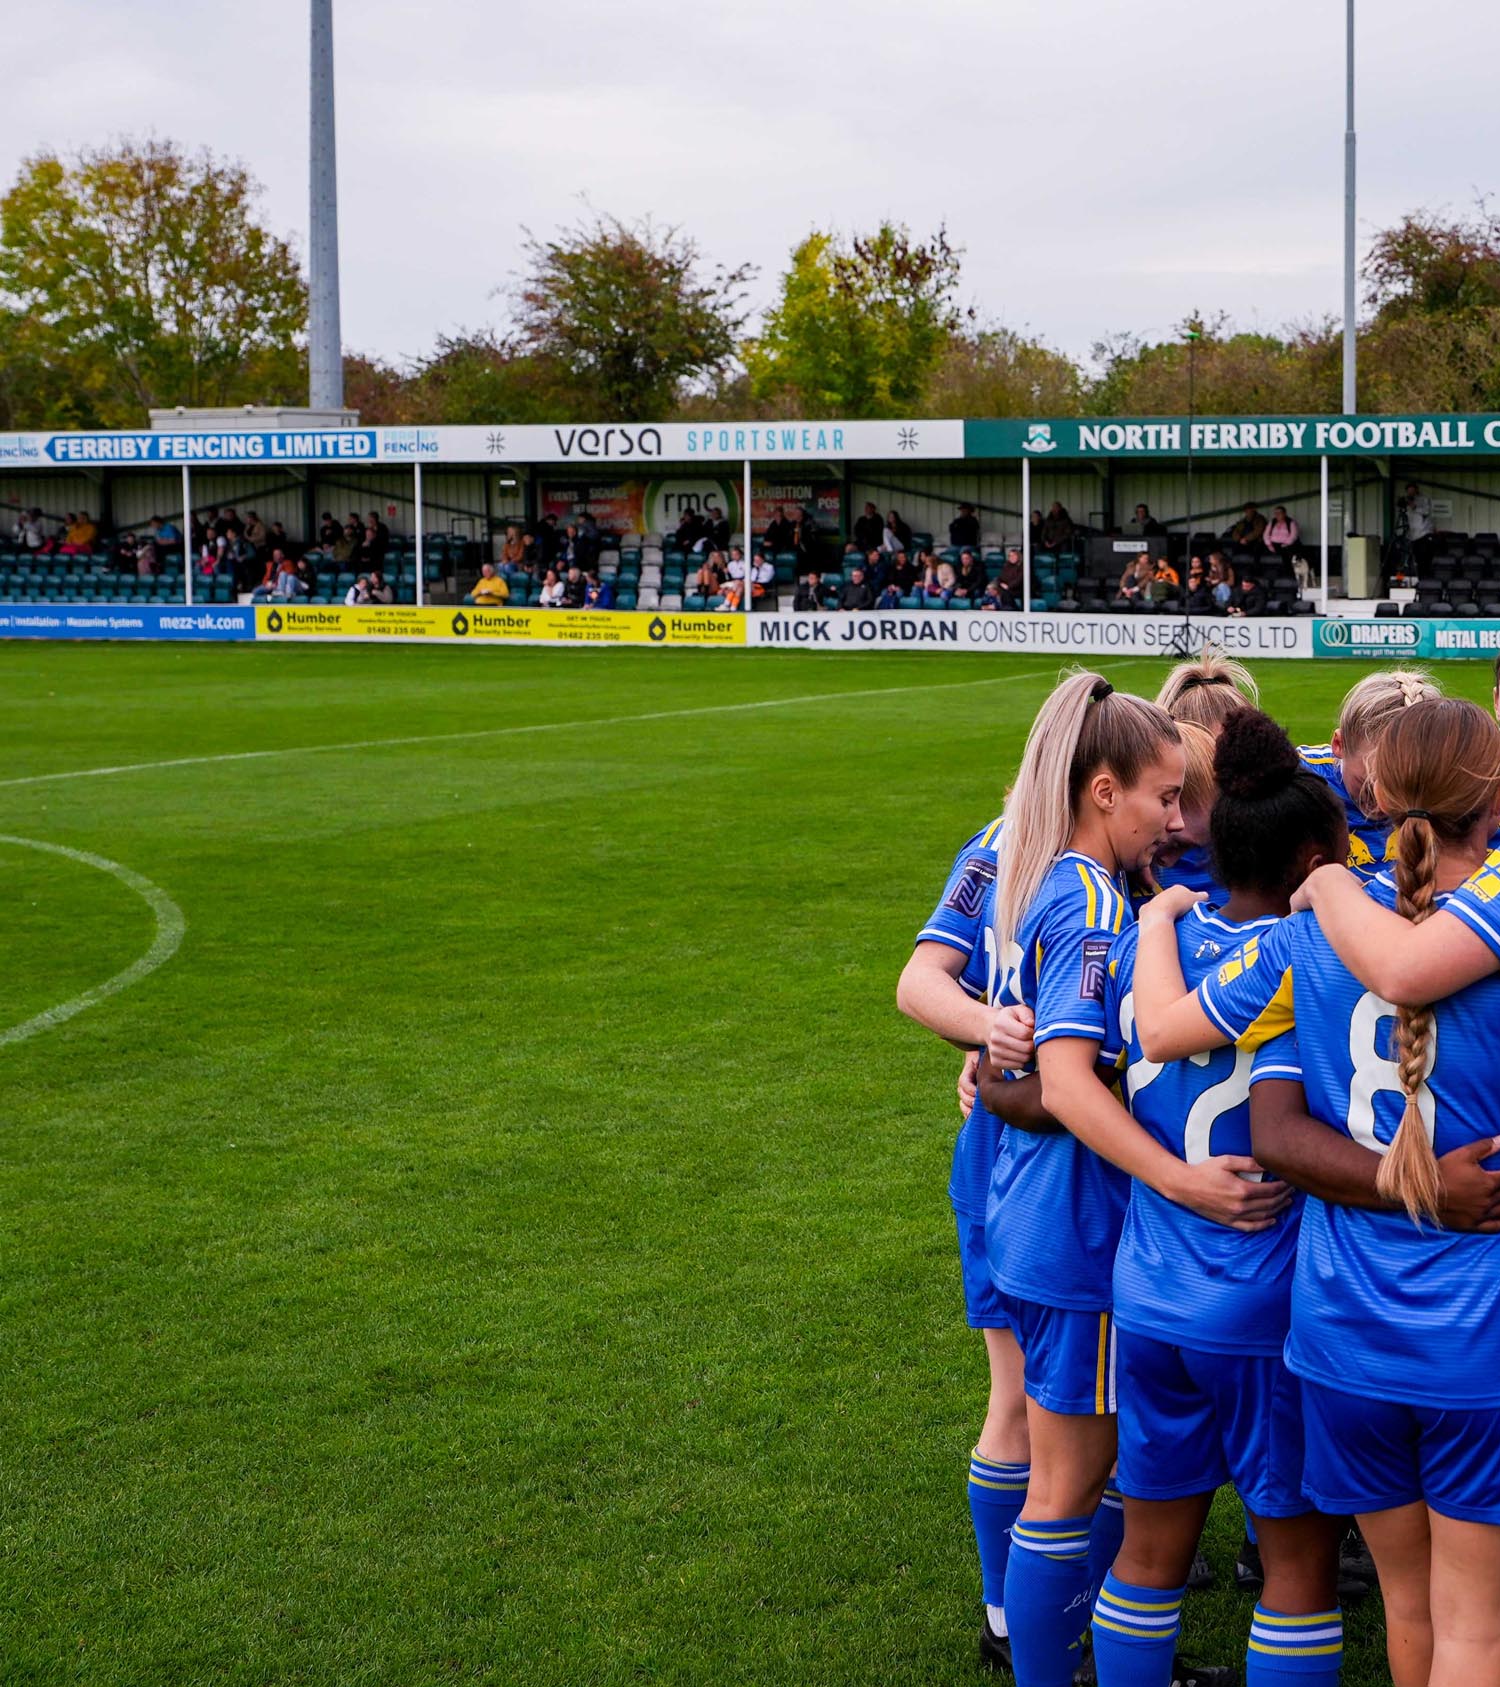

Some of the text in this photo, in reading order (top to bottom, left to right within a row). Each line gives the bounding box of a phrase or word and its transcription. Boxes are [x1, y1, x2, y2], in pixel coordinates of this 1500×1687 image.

[687, 429, 844, 452] SPORTSWEAR
[1078, 424, 1181, 450] NORTH
[1190, 422, 1307, 449] FERRIBY
[1315, 421, 1475, 449] FOOTBALL
[54, 434, 371, 459] FERRIBY FENCING LIMITED
[160, 613, 245, 630] mezz-uk.com
[287, 611, 341, 624] Humber
[473, 614, 531, 628] Humber
[671, 619, 732, 633] Humber
[760, 619, 1297, 648] MICK JORDAN CONSTRUCTION SERVICES LTD
[1351, 624, 1415, 645] DRAPERS
[1435, 630, 1478, 649] METAL
[1347, 990, 1438, 1157] 8
